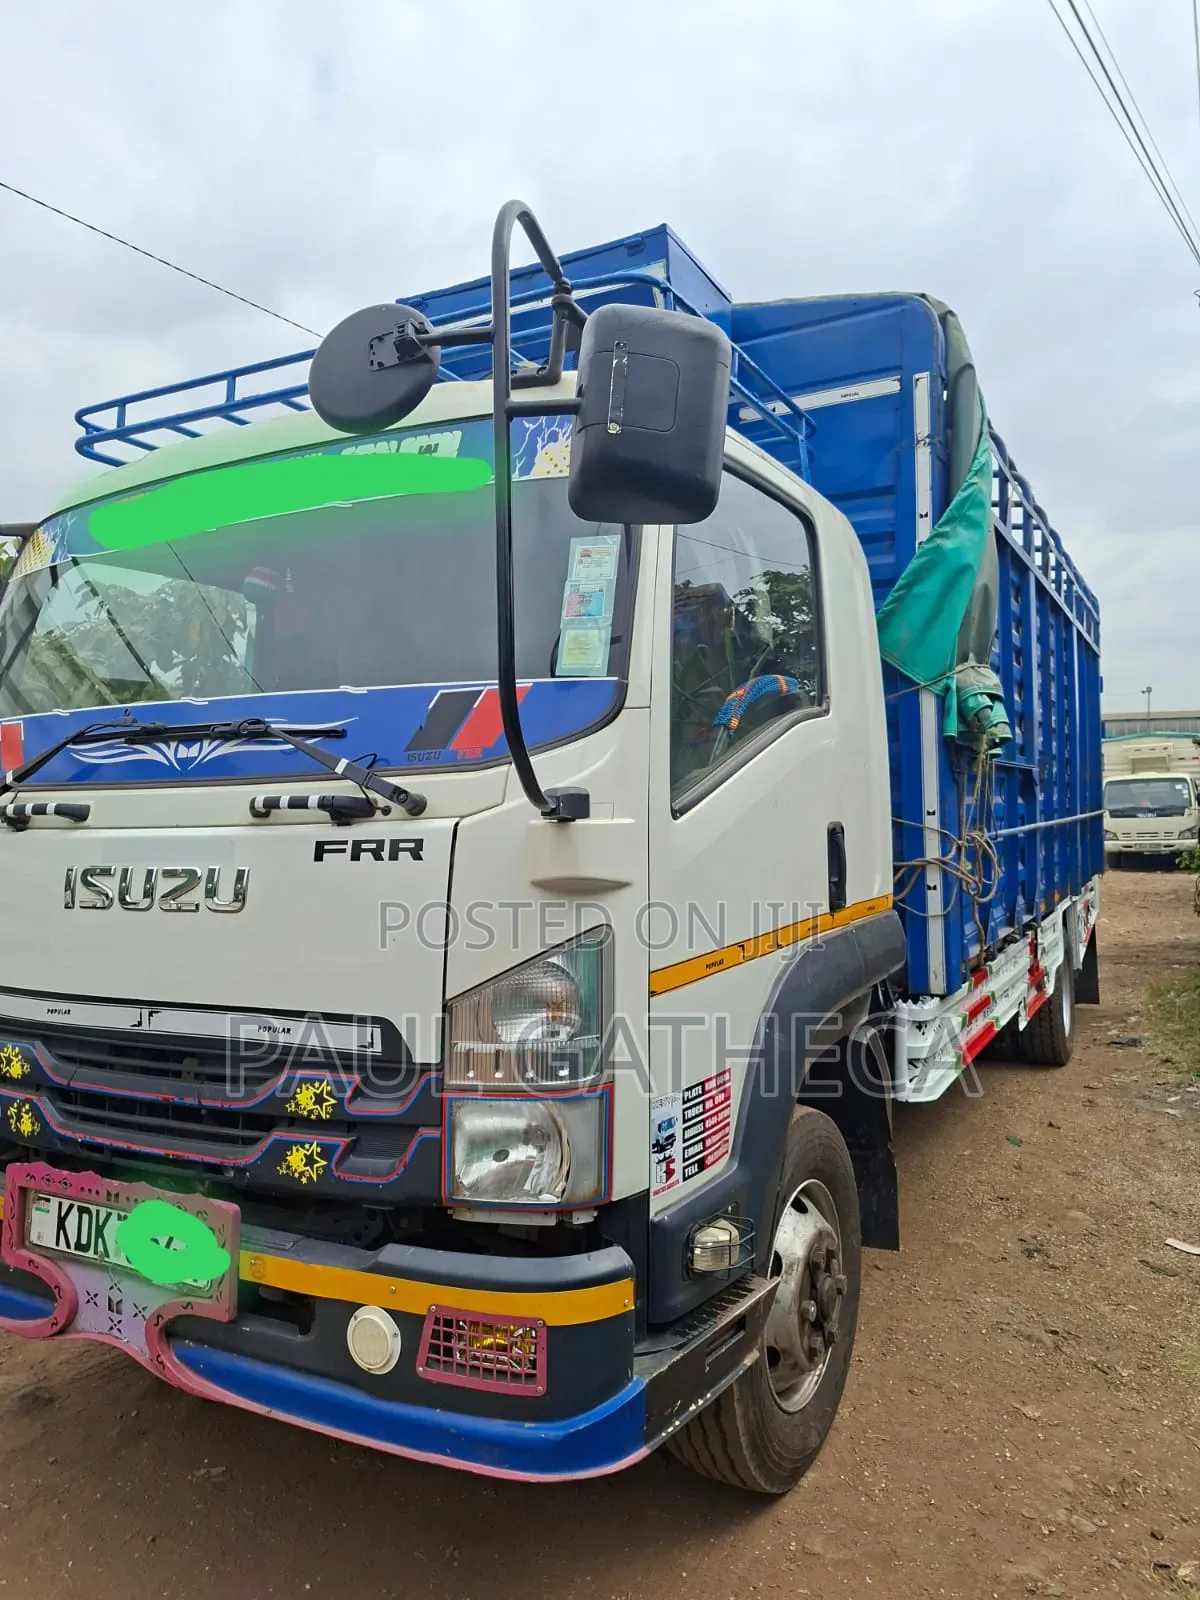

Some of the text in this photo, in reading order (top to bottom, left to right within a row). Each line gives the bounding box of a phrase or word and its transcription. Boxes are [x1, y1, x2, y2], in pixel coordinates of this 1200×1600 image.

[407, 750, 442, 762] ISUZU
[313, 838, 425, 863] FRR
[64, 866, 250, 913] ISUZU
[46, 1008, 71, 1016] POPULAR
[257, 1025, 292, 1034] POPULAR
[684, 1085, 703, 1101] PLATE
[684, 1103, 704, 1120] TRUCK
[684, 1141, 704, 1159] EMAIL
[684, 1162, 700, 1179] TELL
